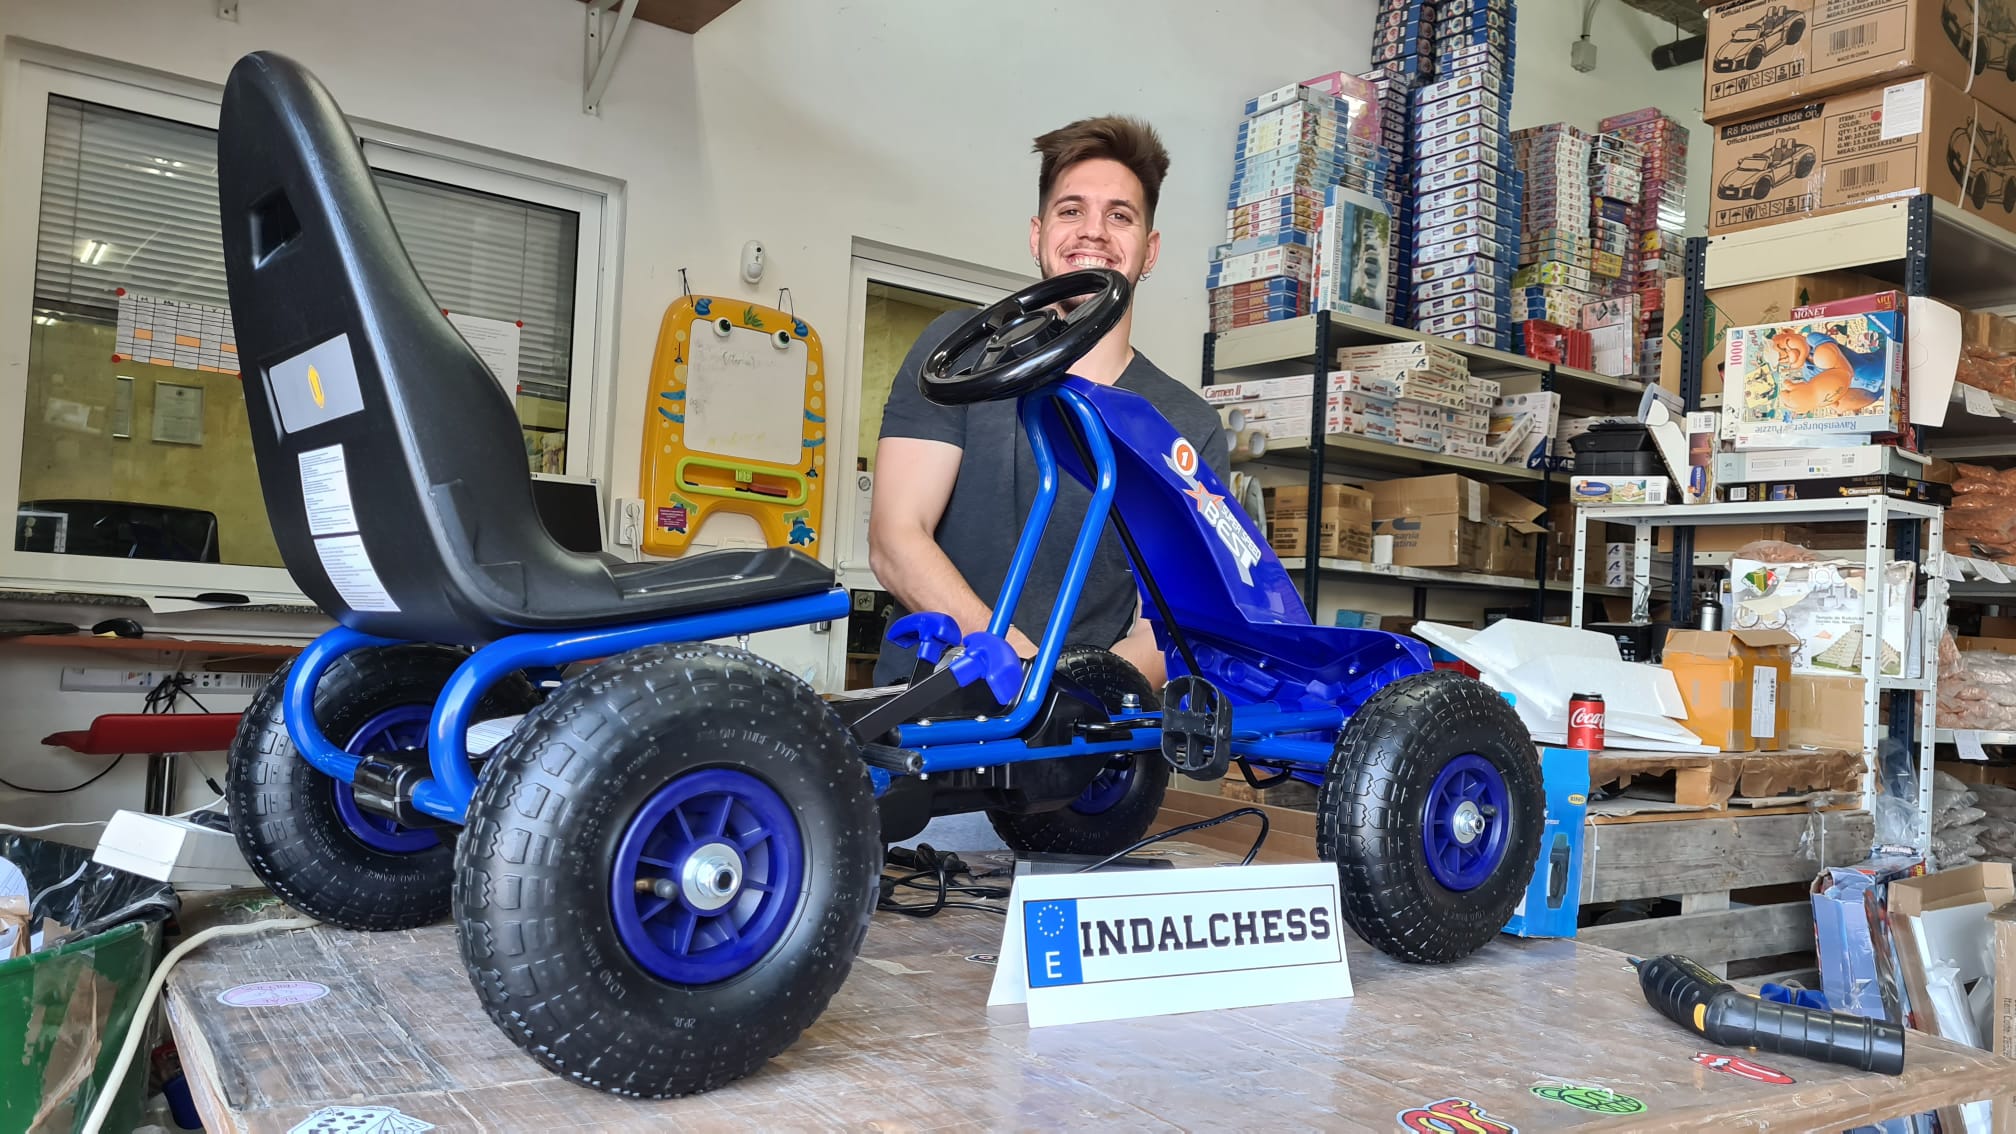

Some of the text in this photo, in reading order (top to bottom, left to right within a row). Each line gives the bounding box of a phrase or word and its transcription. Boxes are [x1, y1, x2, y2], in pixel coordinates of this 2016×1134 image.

[1726, 125, 1739, 137] R8
[1740, 117, 1780, 134] Powered
[1782, 112, 1803, 124] Ride
[1837, 119, 1862, 129] COLOR:
[1838, 113, 1857, 123] ITEM:
[1726, 124, 1801, 146] Official Licensed Product
[1837, 128, 1854, 137] QTY:
[1837, 134, 1854, 143] N.W:
[1836, 141, 1853, 149] G.W:
[1836, 147, 1857, 156] MEAS:
[1788, 198, 1794, 207] 5
[1793, 306, 1827, 319] MONET
[1729, 340, 1744, 366] 1000
[1205, 387, 1235, 399] Carmen
[1755, 420, 1857, 434] Ravensburger Puzzle
[1181, 451, 1189, 467] 1
[1204, 500, 1255, 569] BEST
[1221, 504, 1262, 560] SUPER SPEED
[366, 870, 397, 882] RANGE
[1080, 906, 1331, 957] INDALCHESS
[1045, 951, 1063, 979] E
[600, 969, 627, 1000] LOAD
